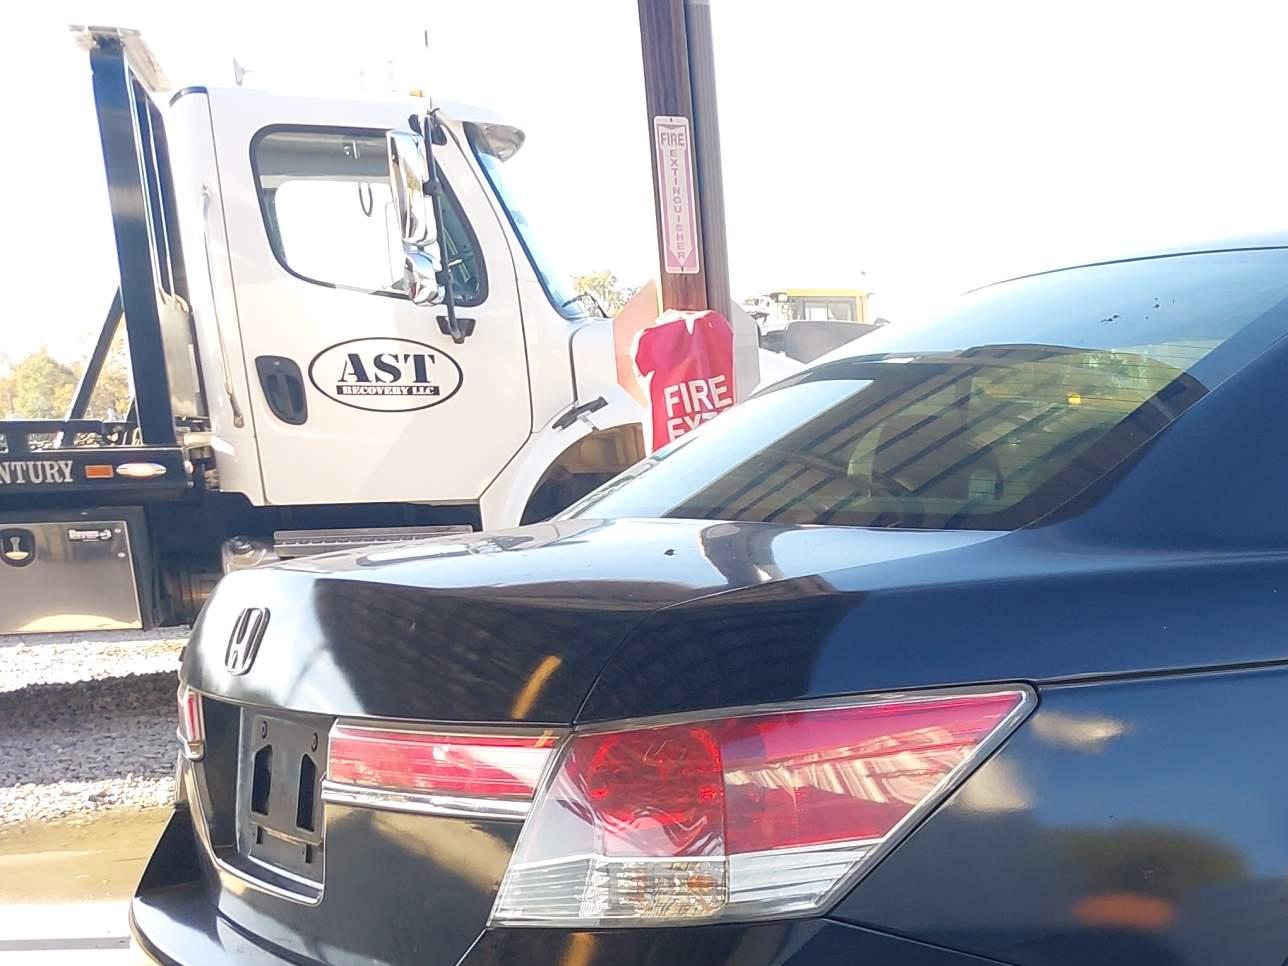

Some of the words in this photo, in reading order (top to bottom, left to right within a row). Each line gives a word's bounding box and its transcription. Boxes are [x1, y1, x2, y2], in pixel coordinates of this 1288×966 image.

[660, 132, 685, 147] FIRE
[669, 149, 686, 260] EXTINGUISHER
[337, 353, 436, 384] AST
[342, 385, 409, 395] RECOVERY
[411, 385, 435, 395] LLC
[663, 374, 732, 418] FIRE
